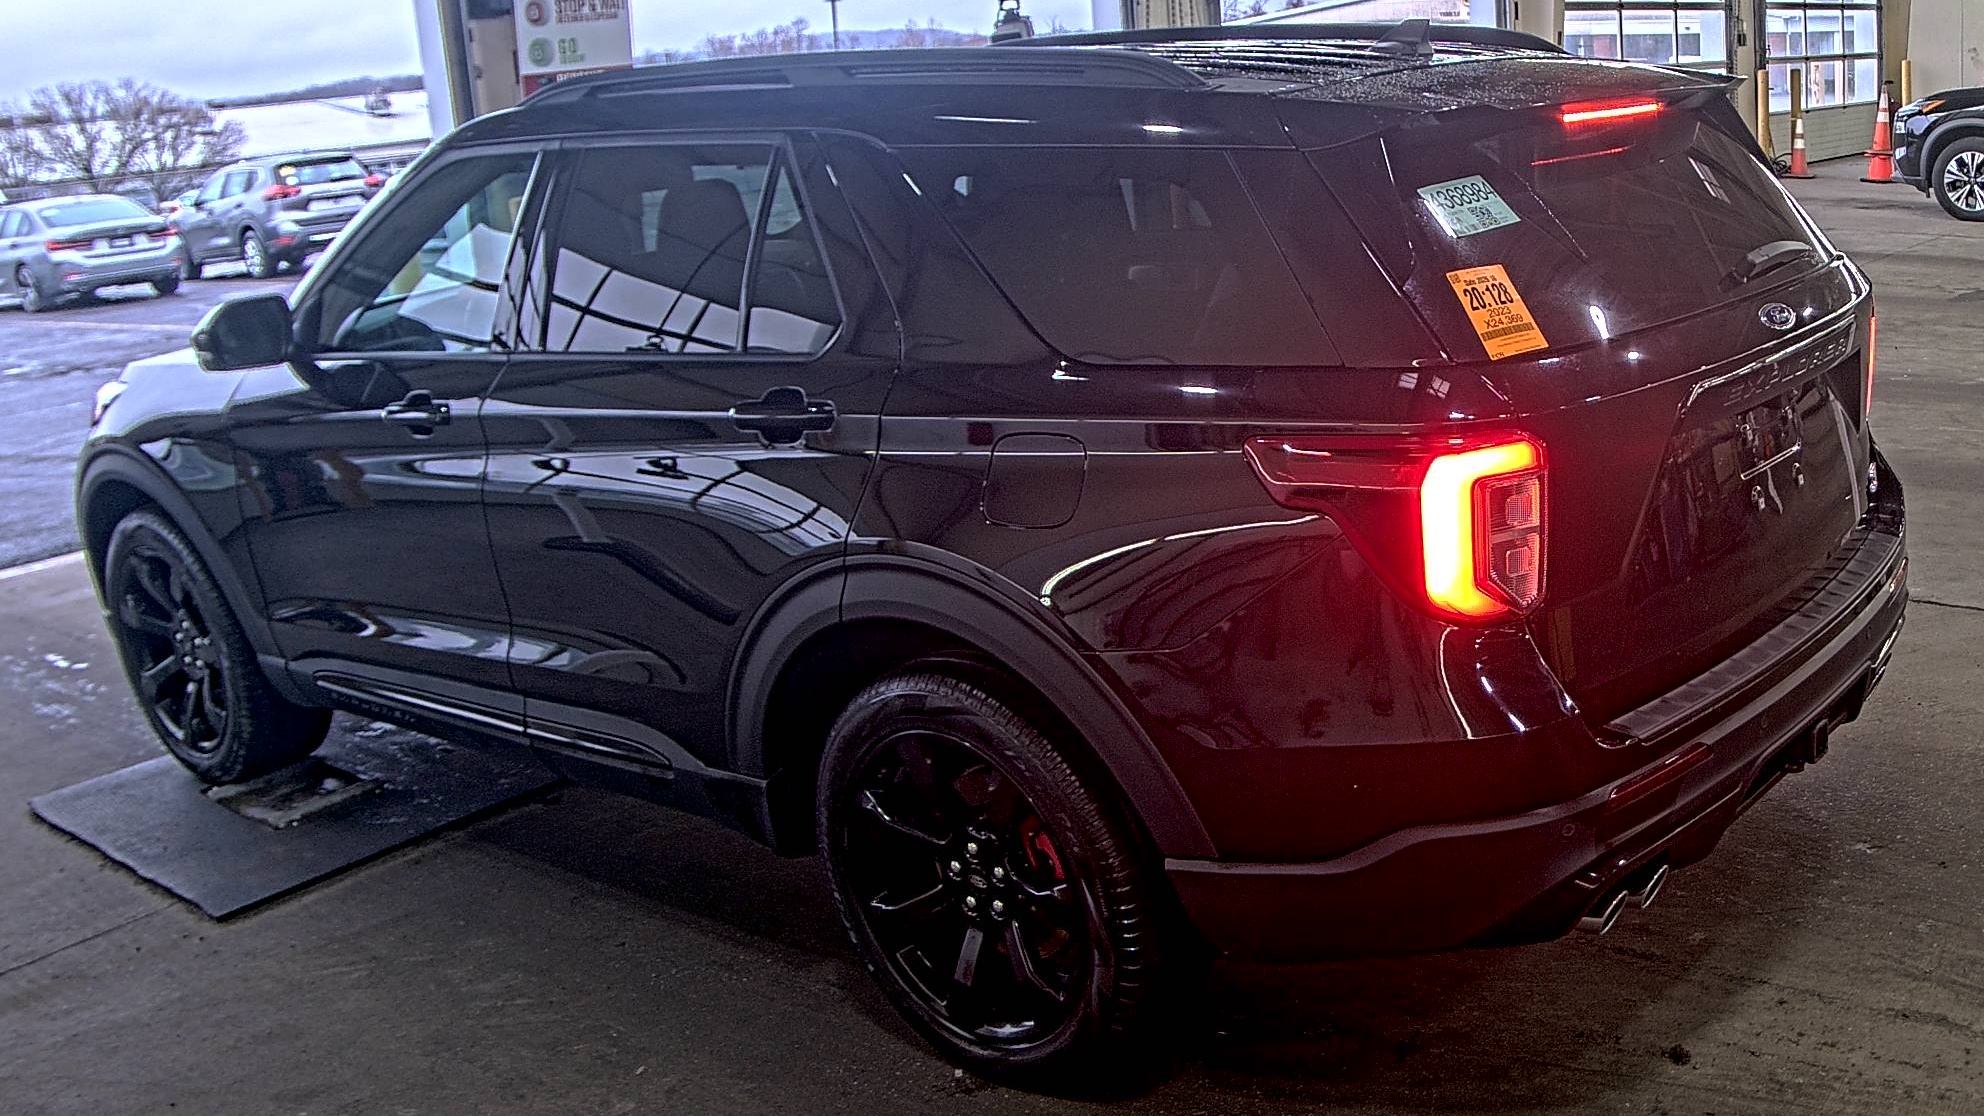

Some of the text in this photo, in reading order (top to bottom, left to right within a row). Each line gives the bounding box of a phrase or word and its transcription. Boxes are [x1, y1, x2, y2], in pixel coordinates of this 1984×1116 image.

[555, 0, 585, 13] STOP
[558, 38, 578, 54] GO
[1429, 181, 1498, 211] 4368984
[1463, 281, 1515, 312] 20:128
[1486, 305, 1512, 318] 2023
